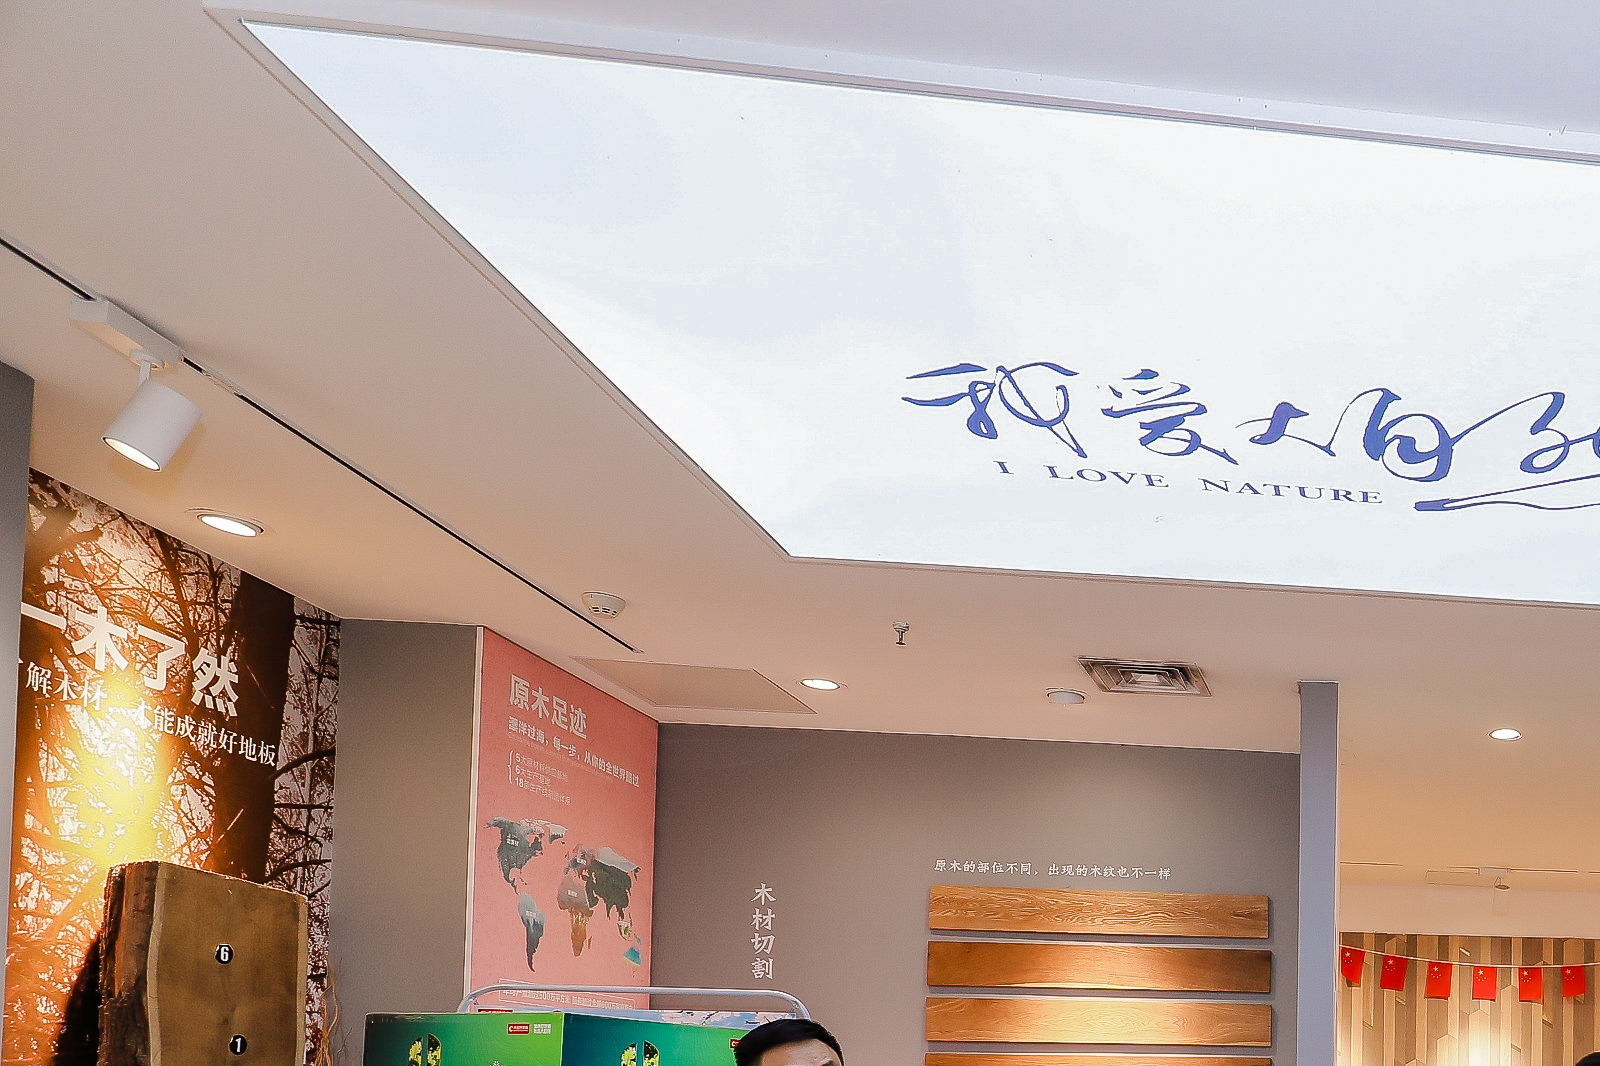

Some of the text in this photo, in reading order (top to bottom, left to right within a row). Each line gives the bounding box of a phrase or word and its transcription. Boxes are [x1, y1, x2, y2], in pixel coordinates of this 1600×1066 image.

[993, 461, 1384, 504] I LOVE NATURE
[21, 602, 240, 717] 一木了然
[510, 674, 587, 740] 原木足迹
[220, 946, 230, 962] 6
[750, 882, 777, 980] 木材切割
